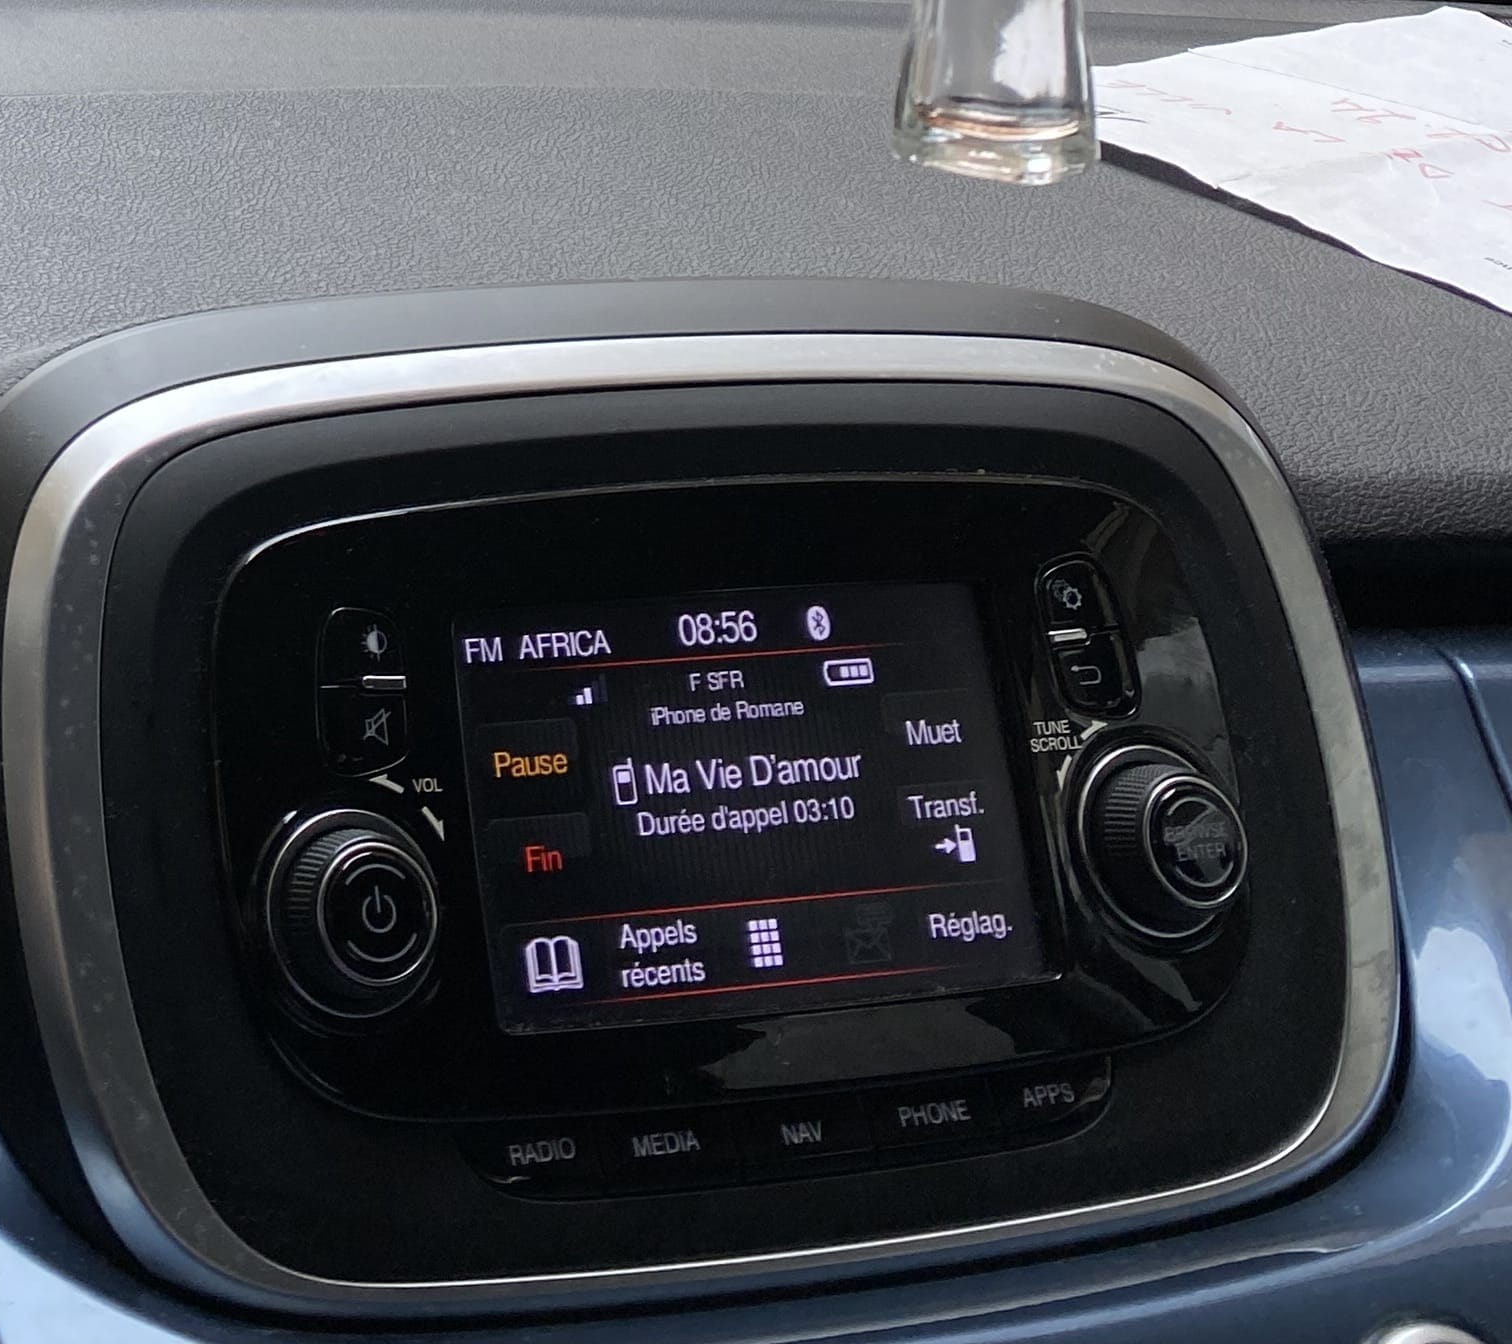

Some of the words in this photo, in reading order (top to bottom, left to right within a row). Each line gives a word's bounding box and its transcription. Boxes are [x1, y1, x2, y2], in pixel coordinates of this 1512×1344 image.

[678, 610, 757, 647] 08:56
[464, 637, 503, 663] FM
[519, 629, 612, 660] AFRICA
[689, 672, 701, 692] F
[706, 670, 745, 692] SFR
[650, 704, 706, 727] iPhone
[711, 702, 733, 722] de
[736, 698, 805, 722] Romane
[905, 719, 962, 746] Muet
[1033, 720, 1071, 736] TUNE
[1030, 736, 1082, 754] SCROLL
[493, 750, 568, 779] Pause
[645, 764, 690, 795] Ma
[695, 758, 744, 791] Vie
[751, 750, 862, 788] D'amour
[412, 778, 443, 793] VOL
[637, 808, 706, 837] Durée
[711, 803, 789, 835] d'appel
[794, 796, 856, 824] 03:10
[908, 792, 985, 820] Transf.
[522, 845, 564, 874] Fin
[620, 920, 697, 953] Appels
[928, 911, 1013, 943] Réglag.
[621, 957, 705, 988] récents
[1023, 1083, 1076, 1109] APPS
[897, 1099, 973, 1128] PHONE
[632, 1129, 702, 1158] MEDIA
[781, 1120, 824, 1146] NAV
[508, 1137, 578, 1167] RADIO
